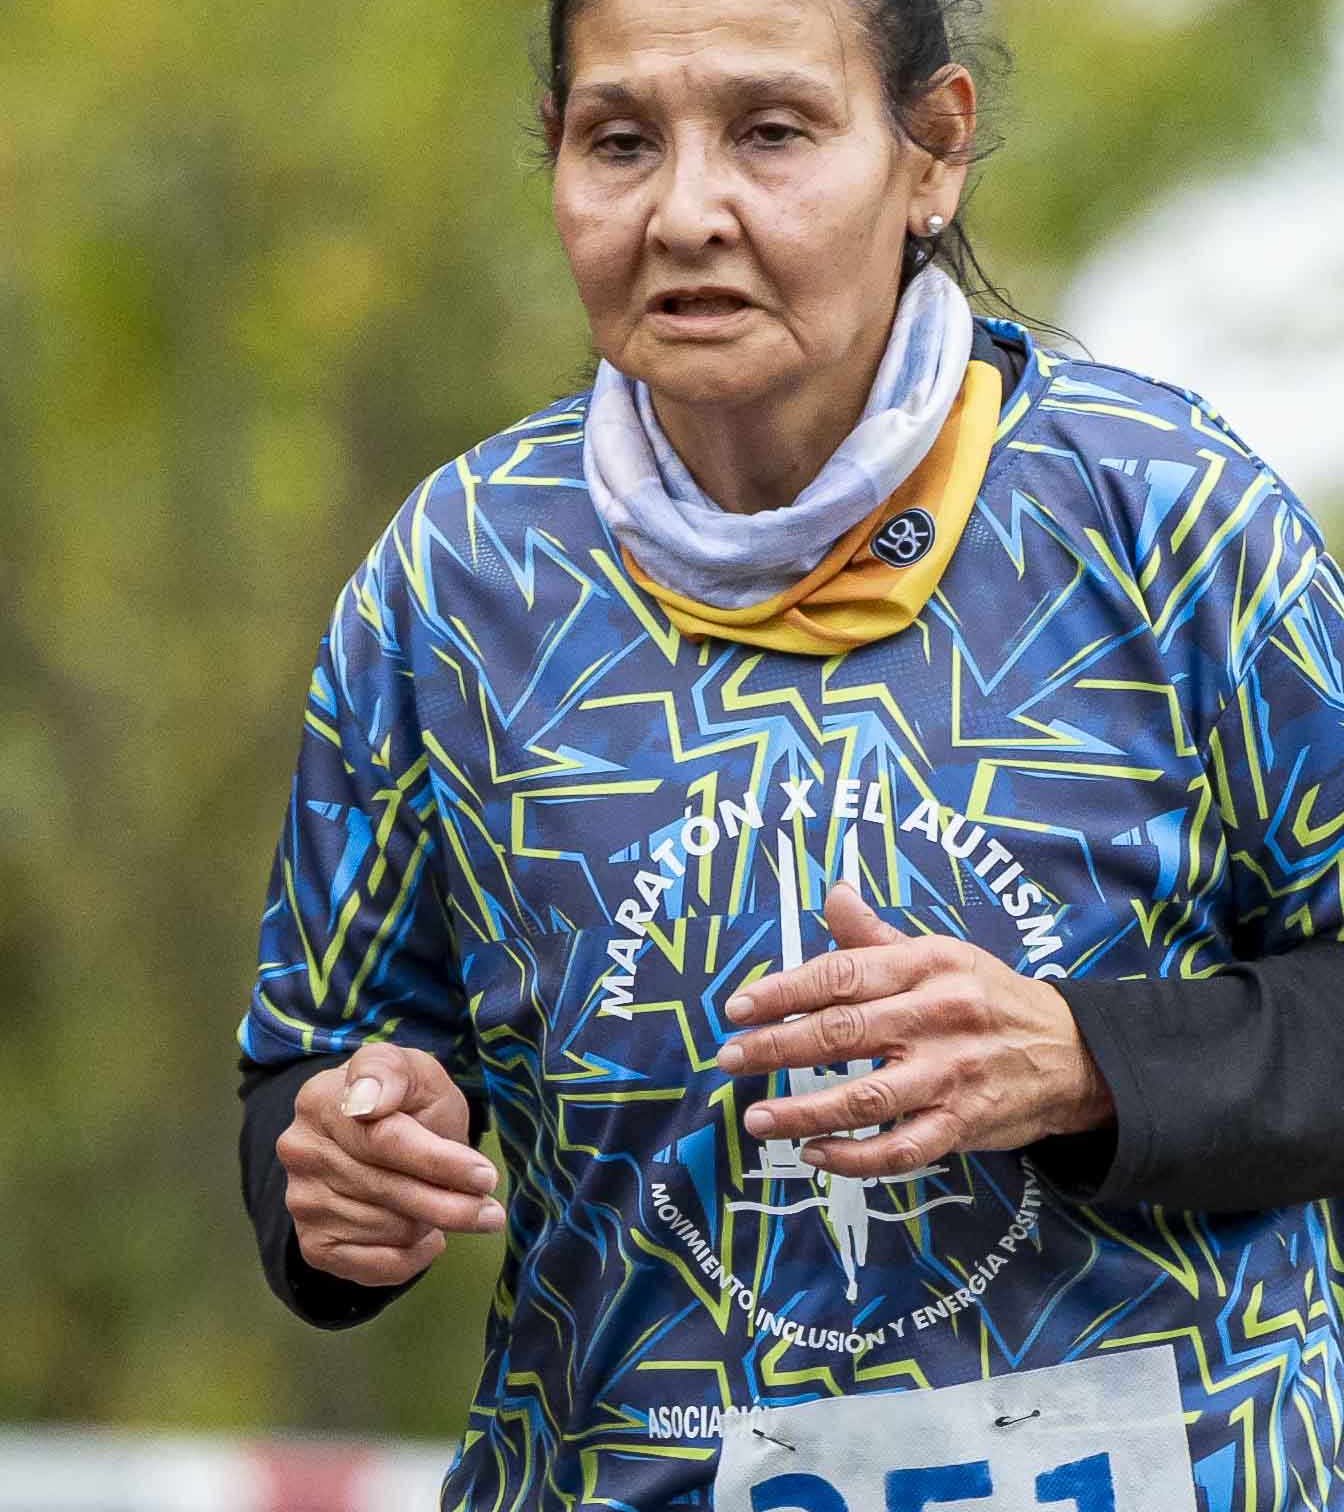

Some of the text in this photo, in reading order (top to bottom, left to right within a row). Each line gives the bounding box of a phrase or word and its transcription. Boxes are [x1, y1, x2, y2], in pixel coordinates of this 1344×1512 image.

[600, 791, 764, 1021] MARATÓN
[780, 779, 817, 821] X
[834, 779, 887, 825] EL
[755, 1308, 885, 1354] INCLUSIÓN
[887, 1317, 905, 1338] Y
[911, 1252, 1009, 1330] ENERGÍA
